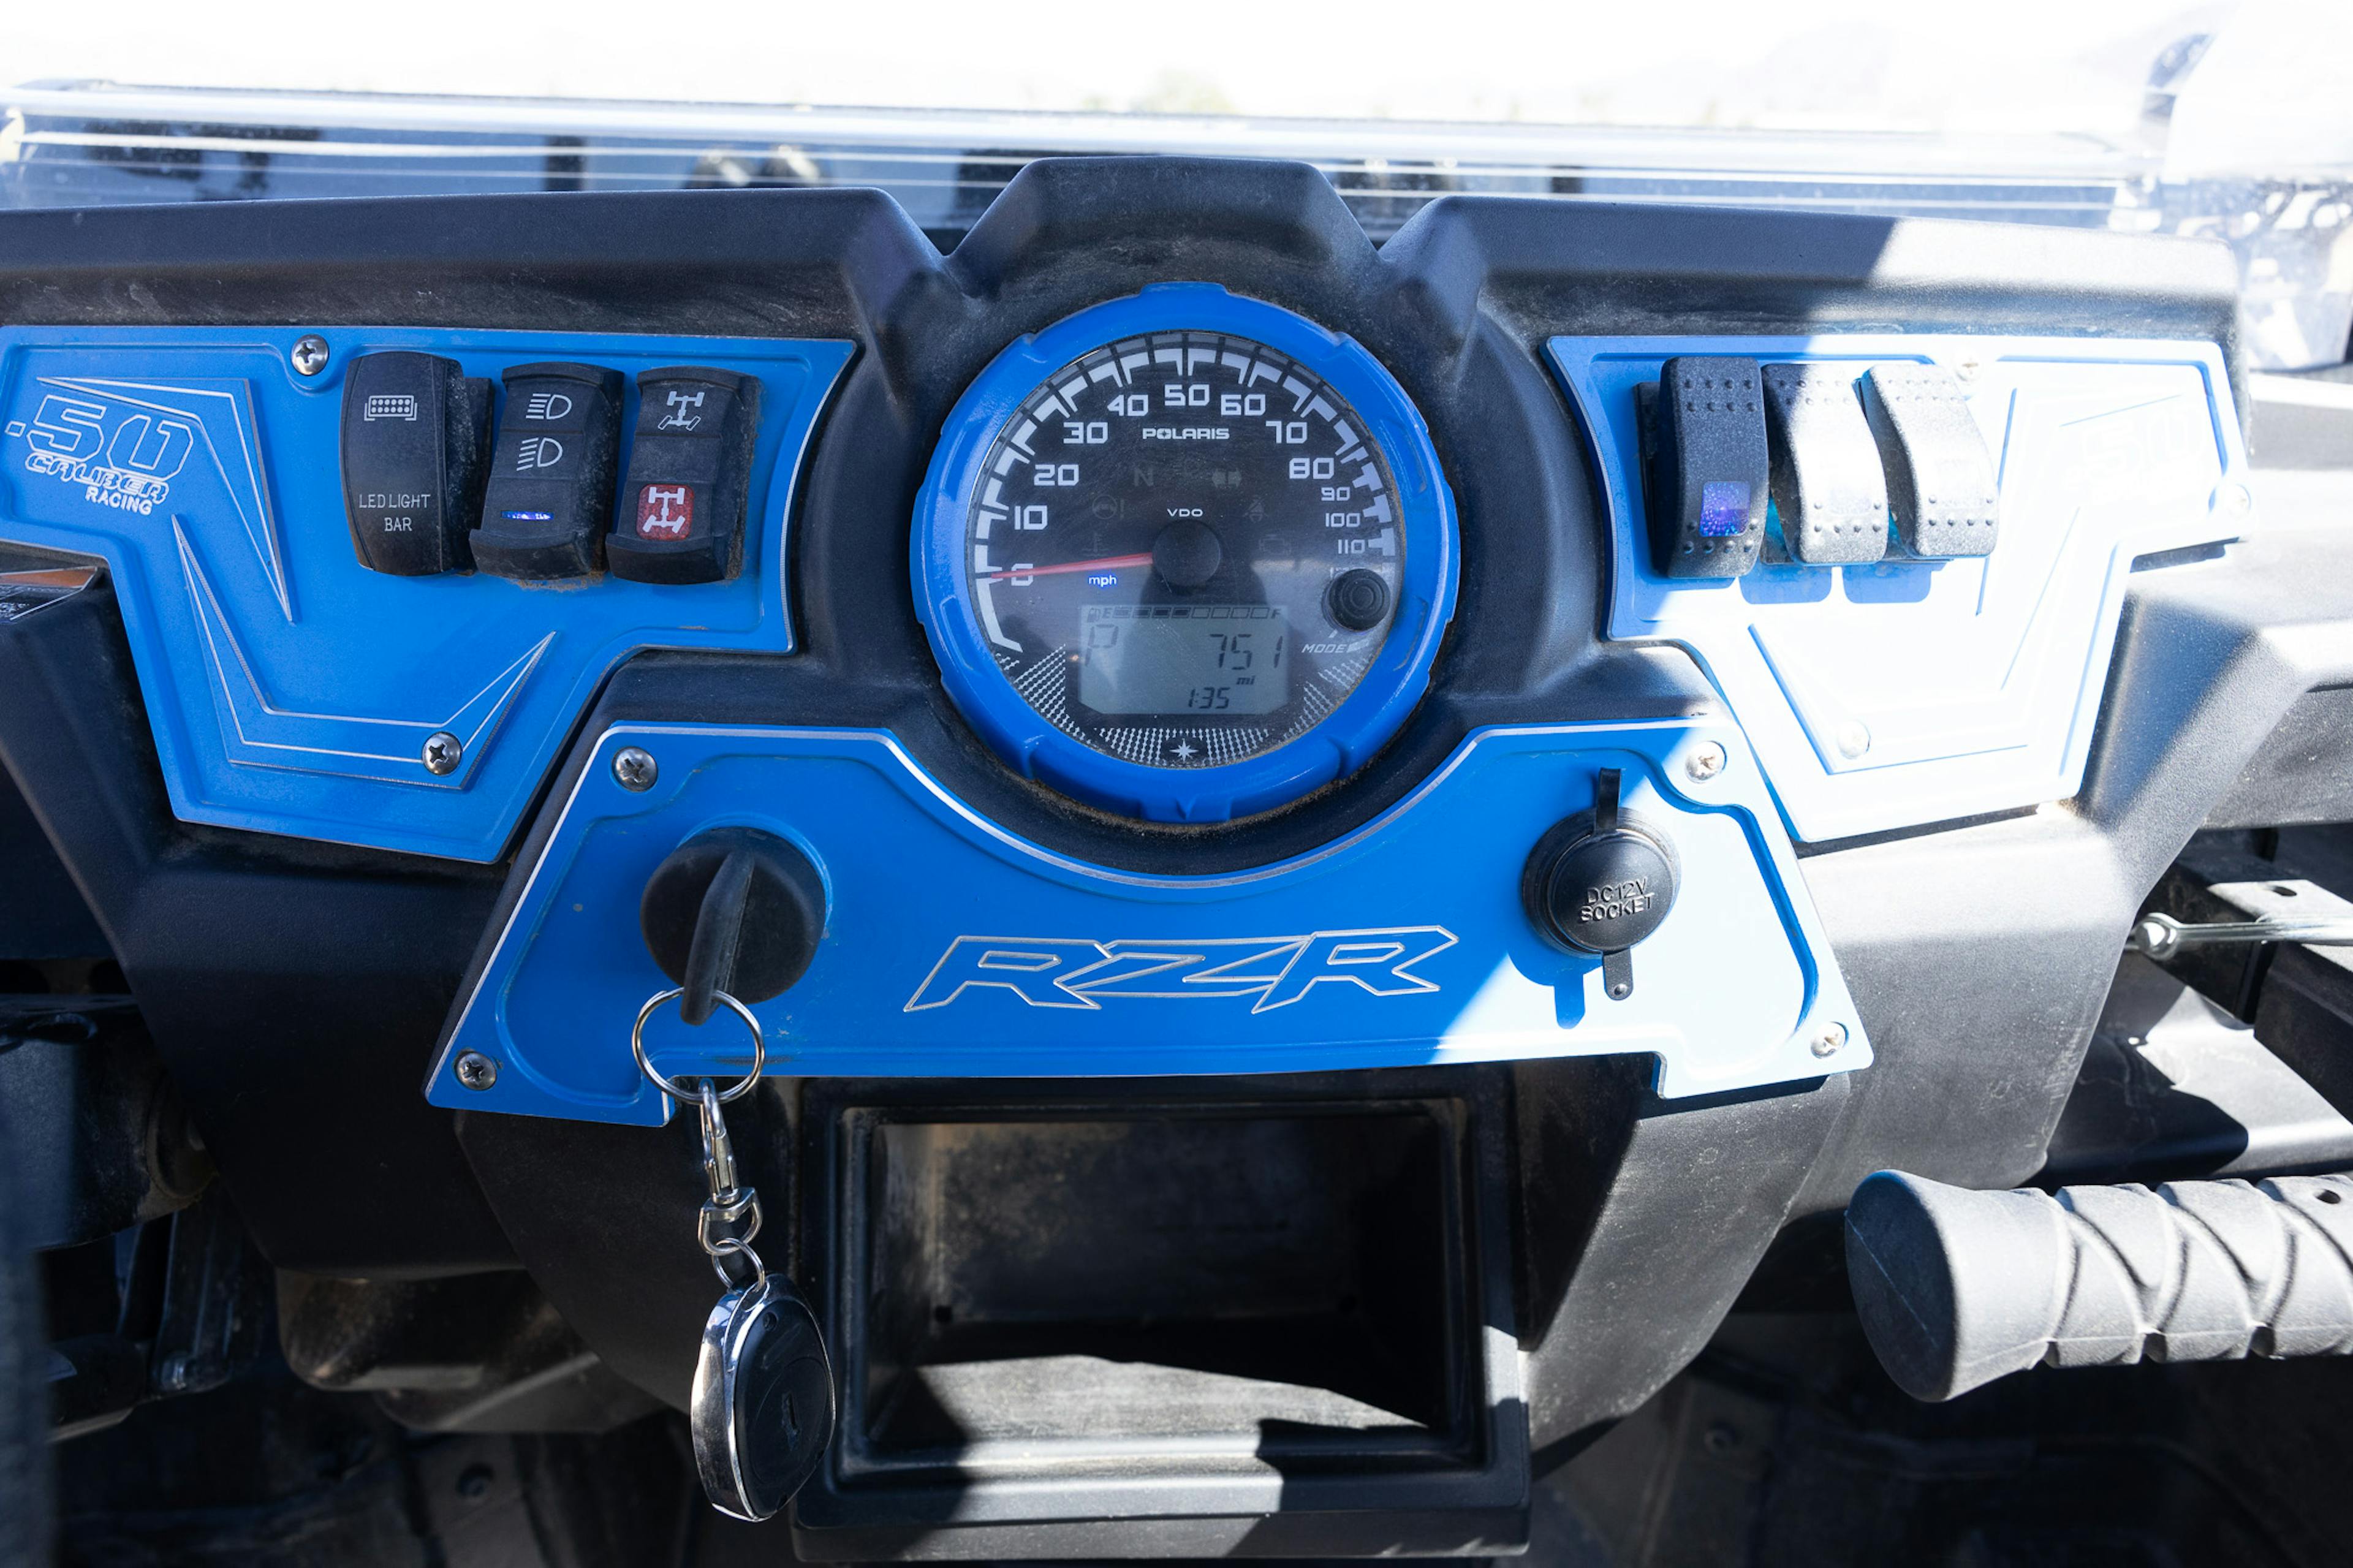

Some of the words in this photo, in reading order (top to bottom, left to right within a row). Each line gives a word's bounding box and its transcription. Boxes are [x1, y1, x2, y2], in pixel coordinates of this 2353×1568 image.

[1107, 394, 1149, 417] 40
[1164, 384, 1210, 406] 50
[1220, 394, 1266, 416] 60
[1063, 422, 1108, 444] 30
[1142, 427, 1230, 439] POLARIS
[1265, 420, 1308, 444] 70
[25, 452, 169, 504] CALIBER
[1034, 464, 1080, 486] 20
[1289, 457, 1335, 480] 80
[85, 486, 153, 516] RACING
[358, 494, 386, 509] LED
[388, 494, 431, 509] LIGHT
[1320, 487, 1351, 501] 90
[1014, 505, 1048, 530] 10
[1167, 508, 1203, 518] VDO
[1325, 512, 1360, 528] 100
[384, 517, 412, 532] BAR
[1338, 539, 1366, 555] 110
[1088, 574, 1117, 588] mph
[1302, 643, 1347, 653] MODE
[1236, 675, 1256, 685] mi
[1188, 686, 1231, 710] 1:35
[1579, 892, 1654, 922] SOCKET
[903, 925, 1460, 1014] RZR
